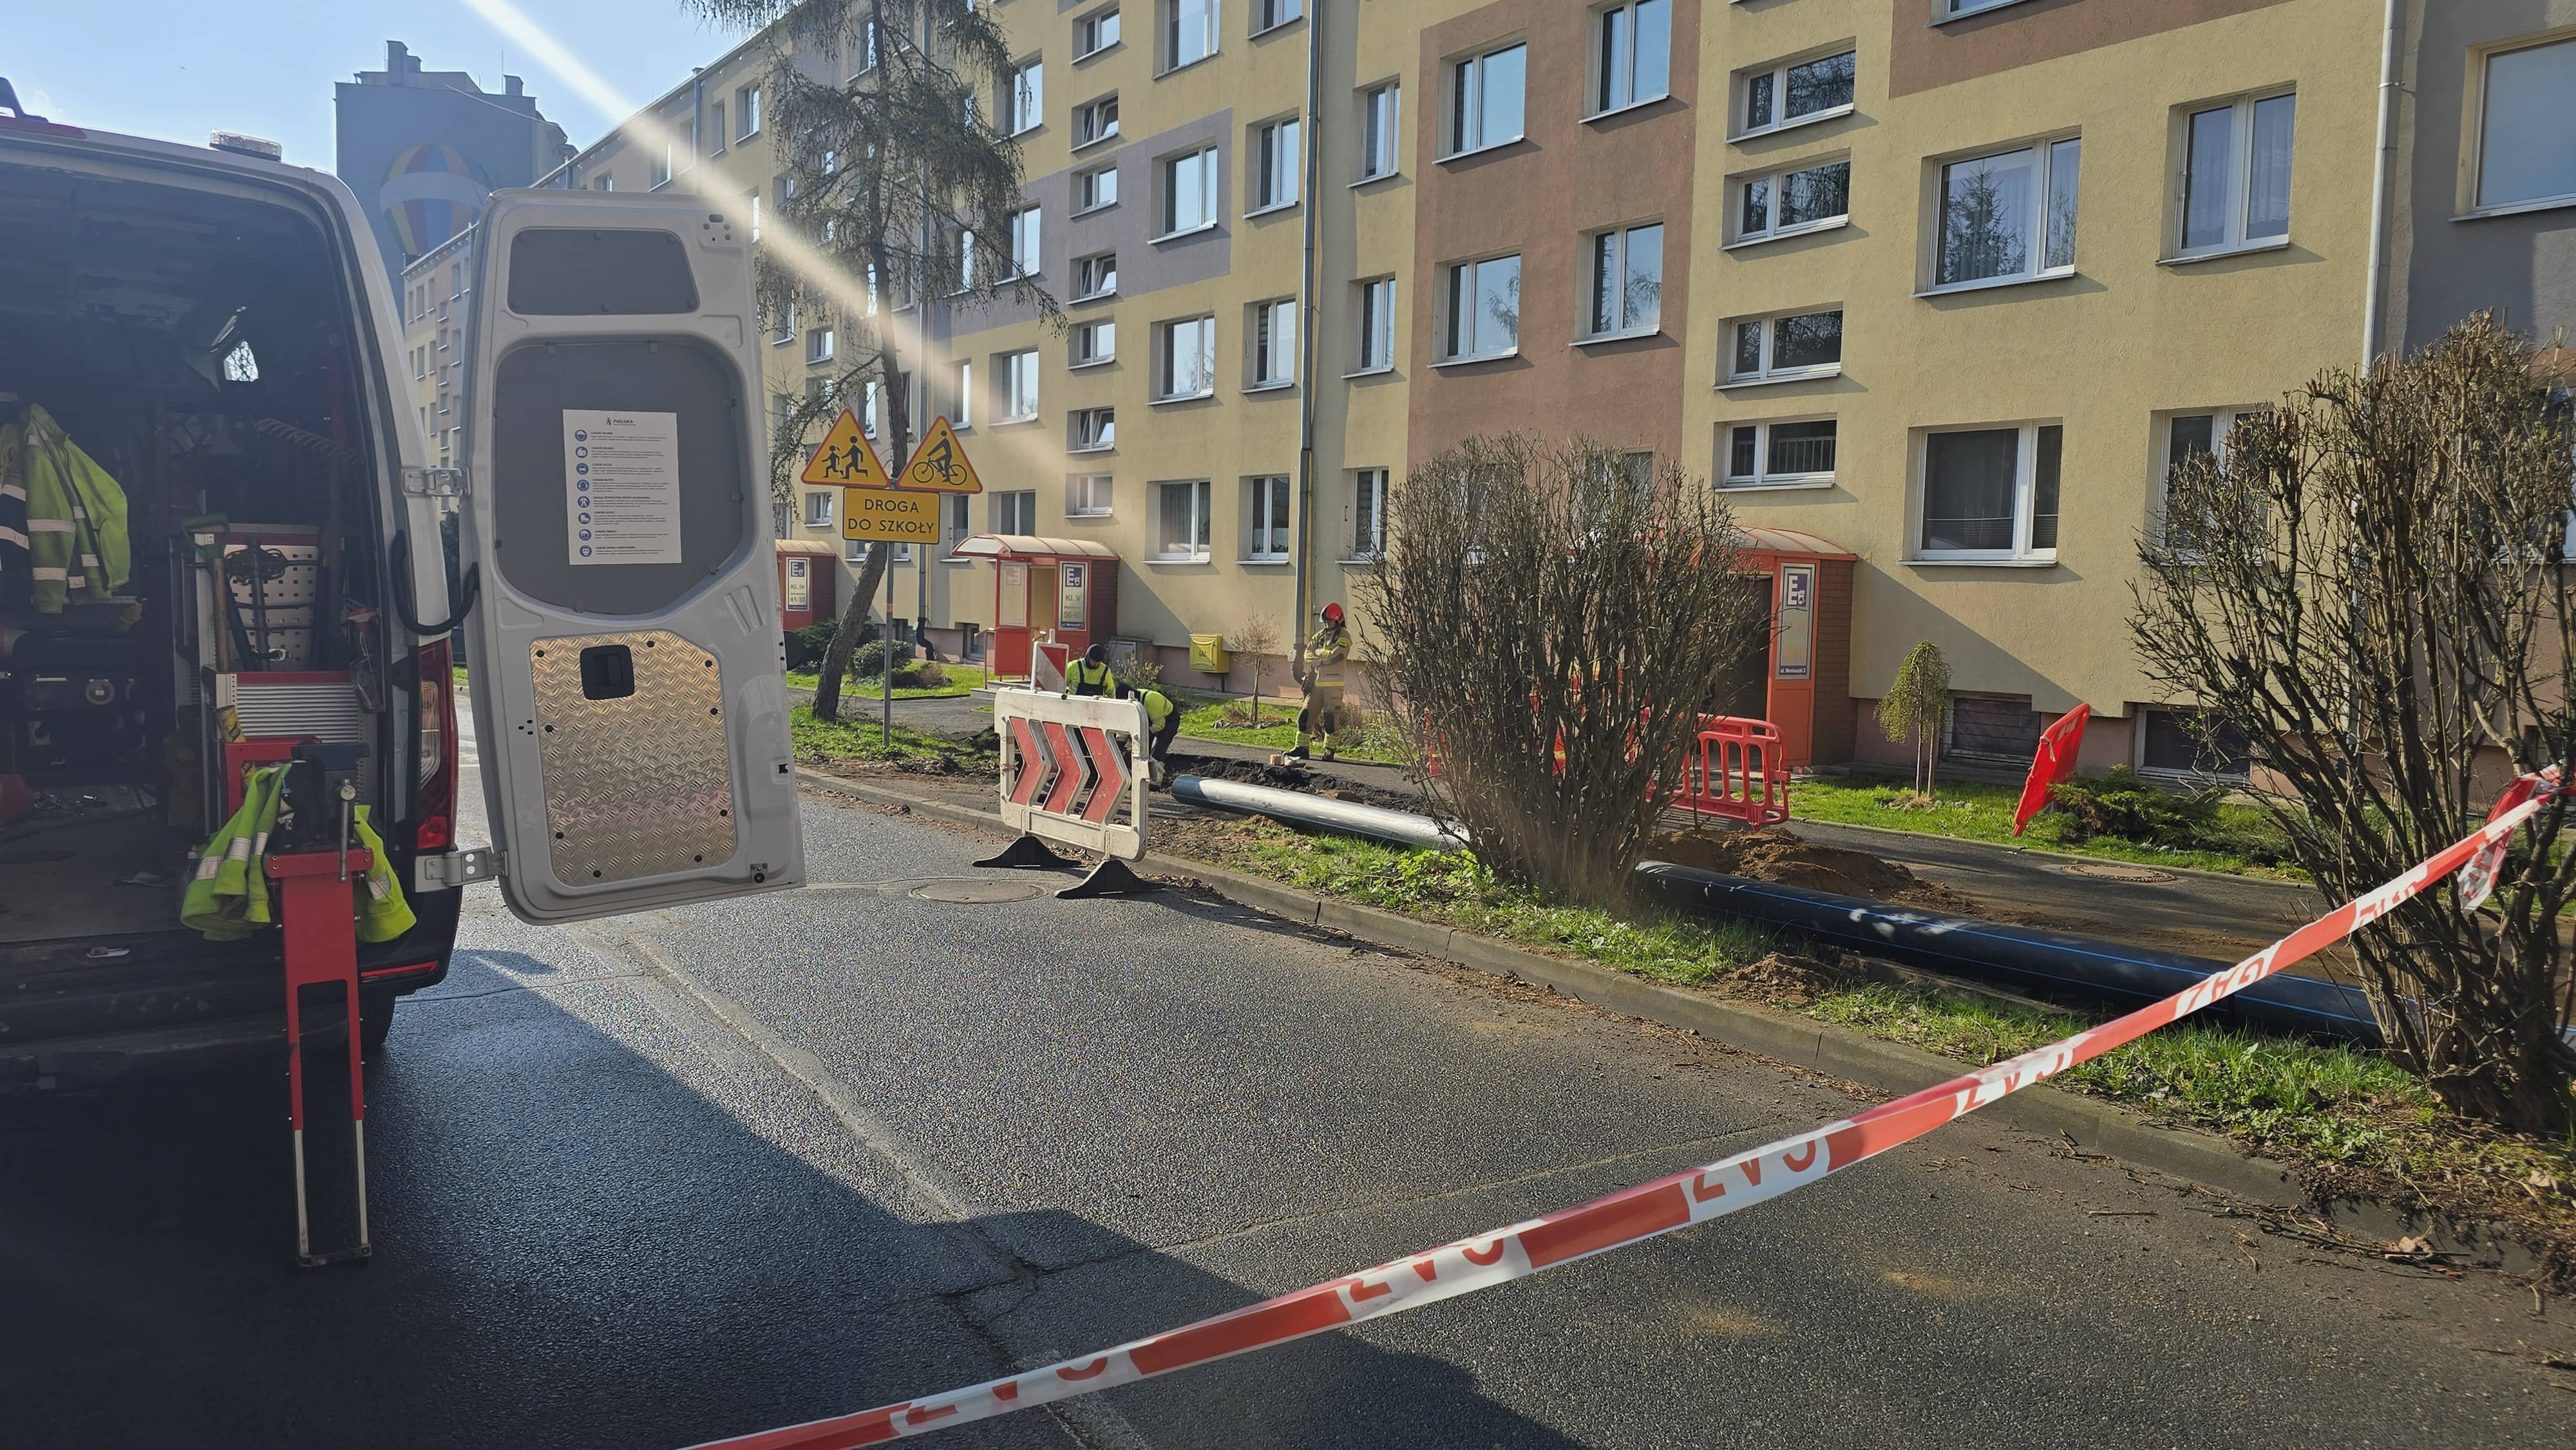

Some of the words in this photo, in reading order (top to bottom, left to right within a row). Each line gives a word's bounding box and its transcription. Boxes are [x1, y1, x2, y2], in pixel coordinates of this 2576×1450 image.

[865, 499, 919, 513] DROGA
[848, 518, 871, 530] DO
[878, 520, 934, 534] SZKOŁY
